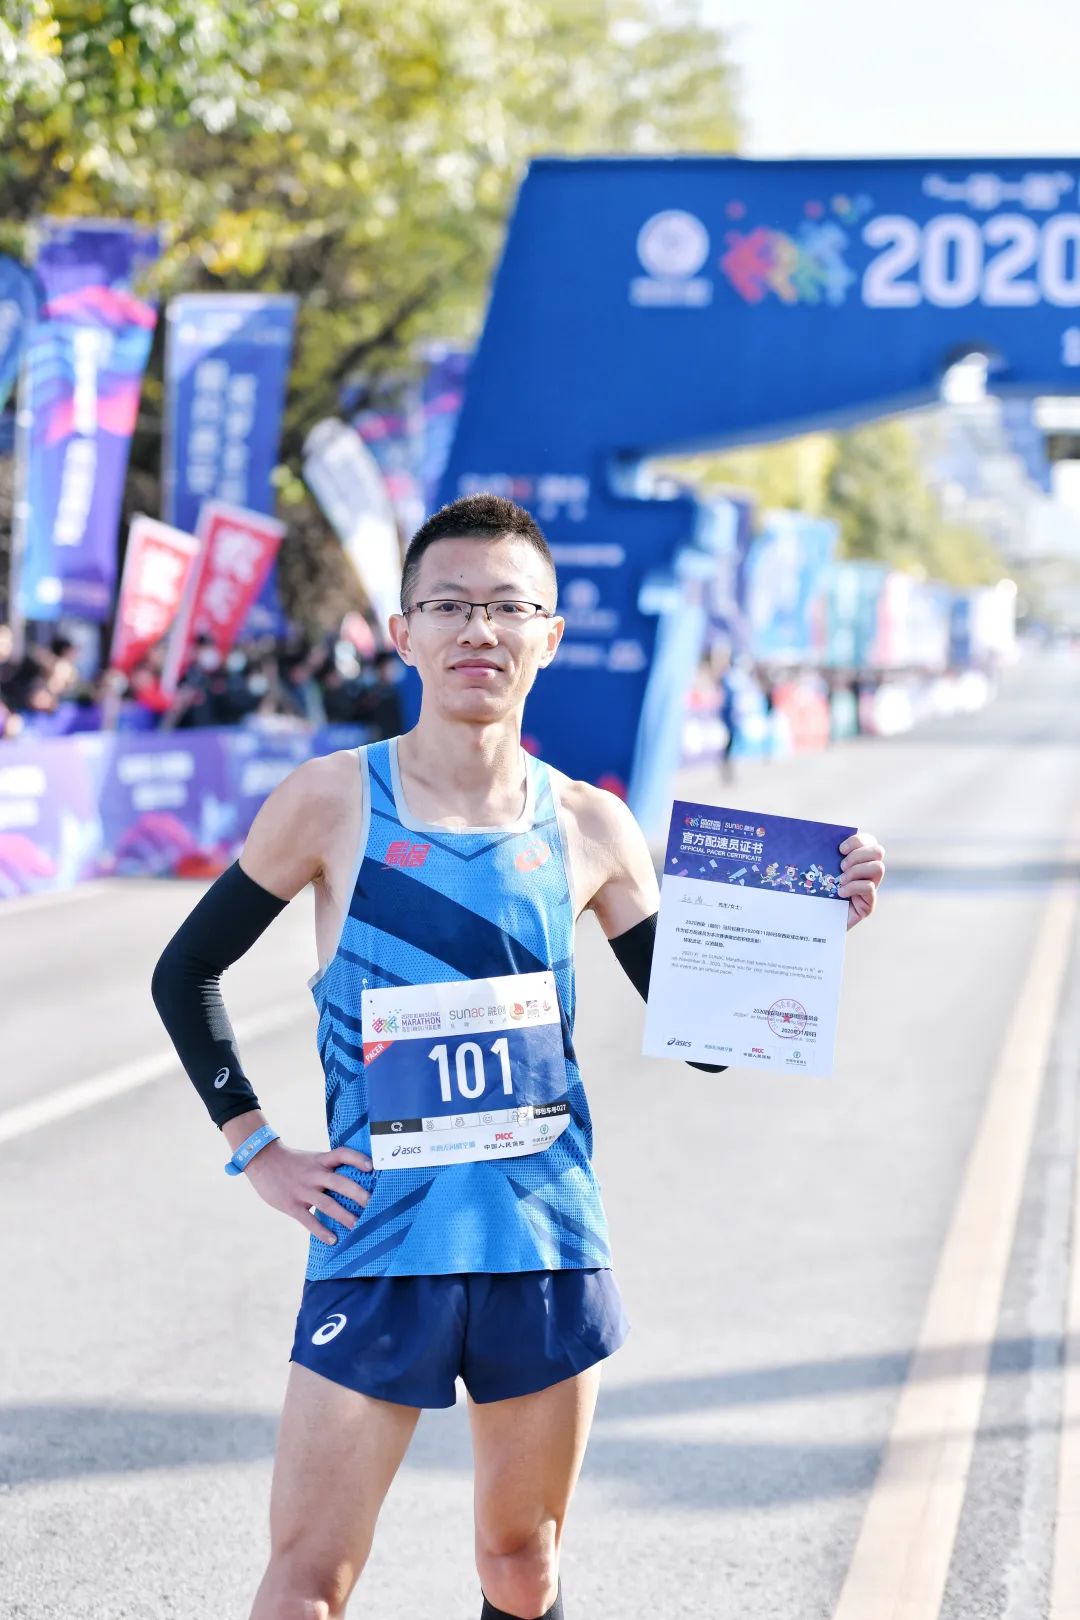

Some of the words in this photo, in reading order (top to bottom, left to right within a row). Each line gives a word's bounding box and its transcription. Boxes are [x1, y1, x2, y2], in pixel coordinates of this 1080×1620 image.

[861, 213, 1080, 308] 2020
[682, 831, 764, 855] 官方配速员证书
[680, 844, 705, 854] OFFICIAL
[706, 848, 726, 857] PACER
[727, 851, 763, 862] CERTIFICATE
[401, 1016, 441, 1027] MARATHON
[449, 1007, 485, 1021] sunac
[364, 1042, 385, 1063] PACER
[428, 1037, 513, 1102] 101
[495, 1132, 514, 1141] PICC
[401, 1146, 422, 1155] asics
[484, 1140, 525, 1151] 中国人民保险
